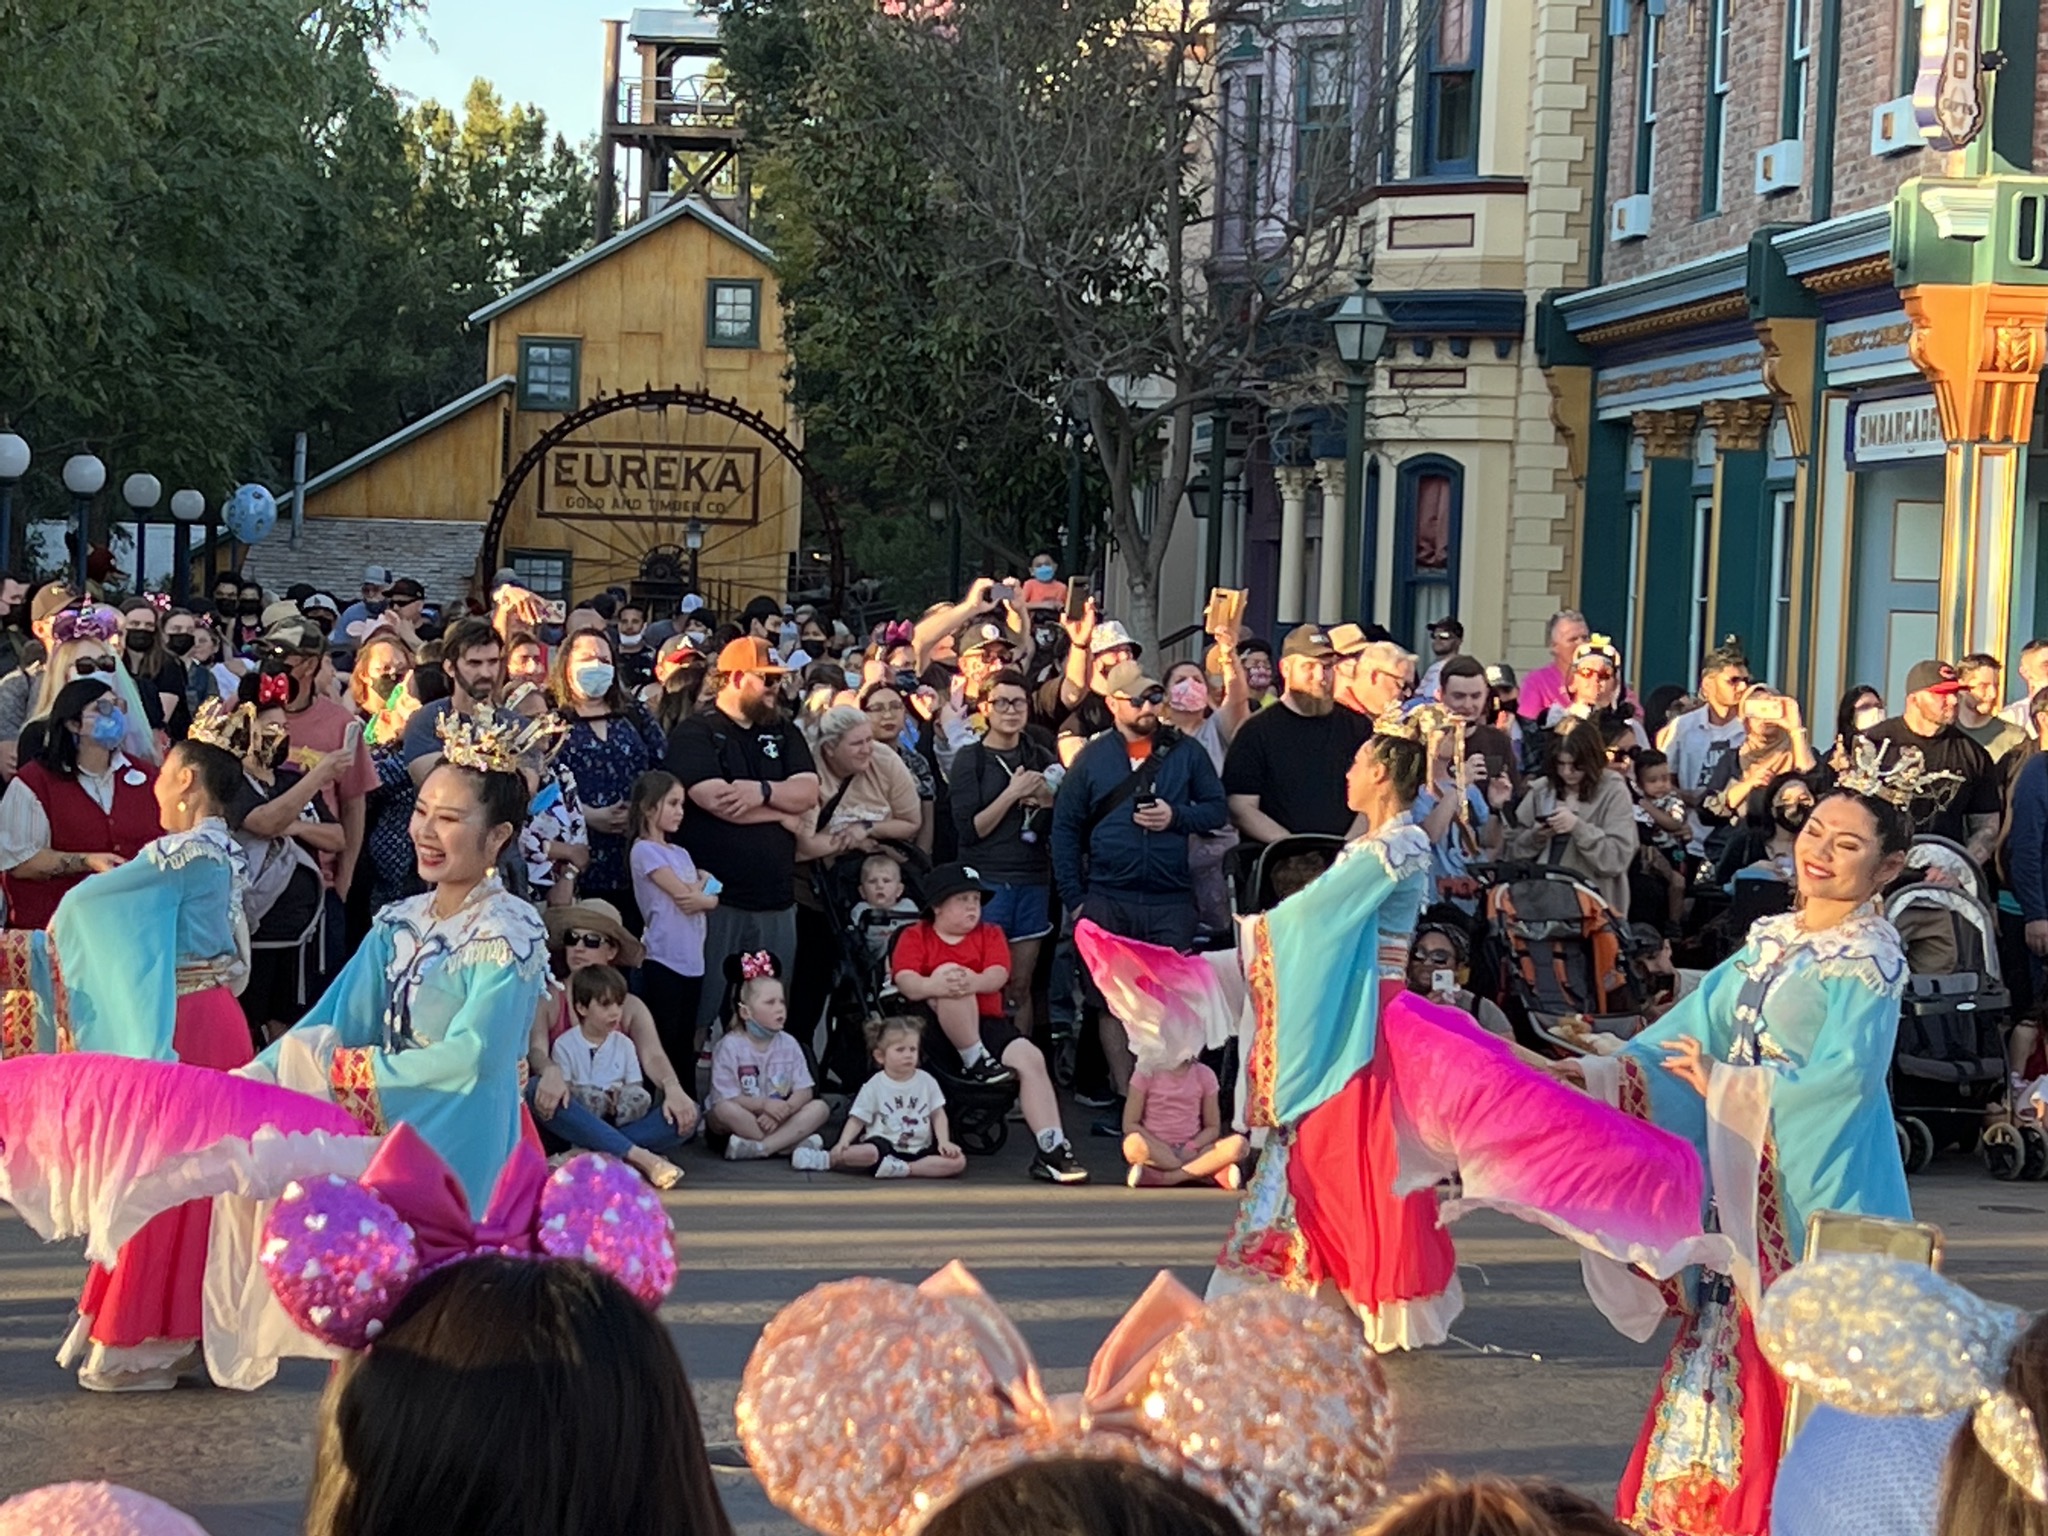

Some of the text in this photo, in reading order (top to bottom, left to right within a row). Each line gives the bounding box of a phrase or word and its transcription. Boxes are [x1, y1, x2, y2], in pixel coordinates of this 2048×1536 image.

[555, 453, 746, 493] EUREKA
[566, 496, 604, 510] GOLD
[611, 497, 642, 511] AND
[648, 499, 700, 513] TIMBER
